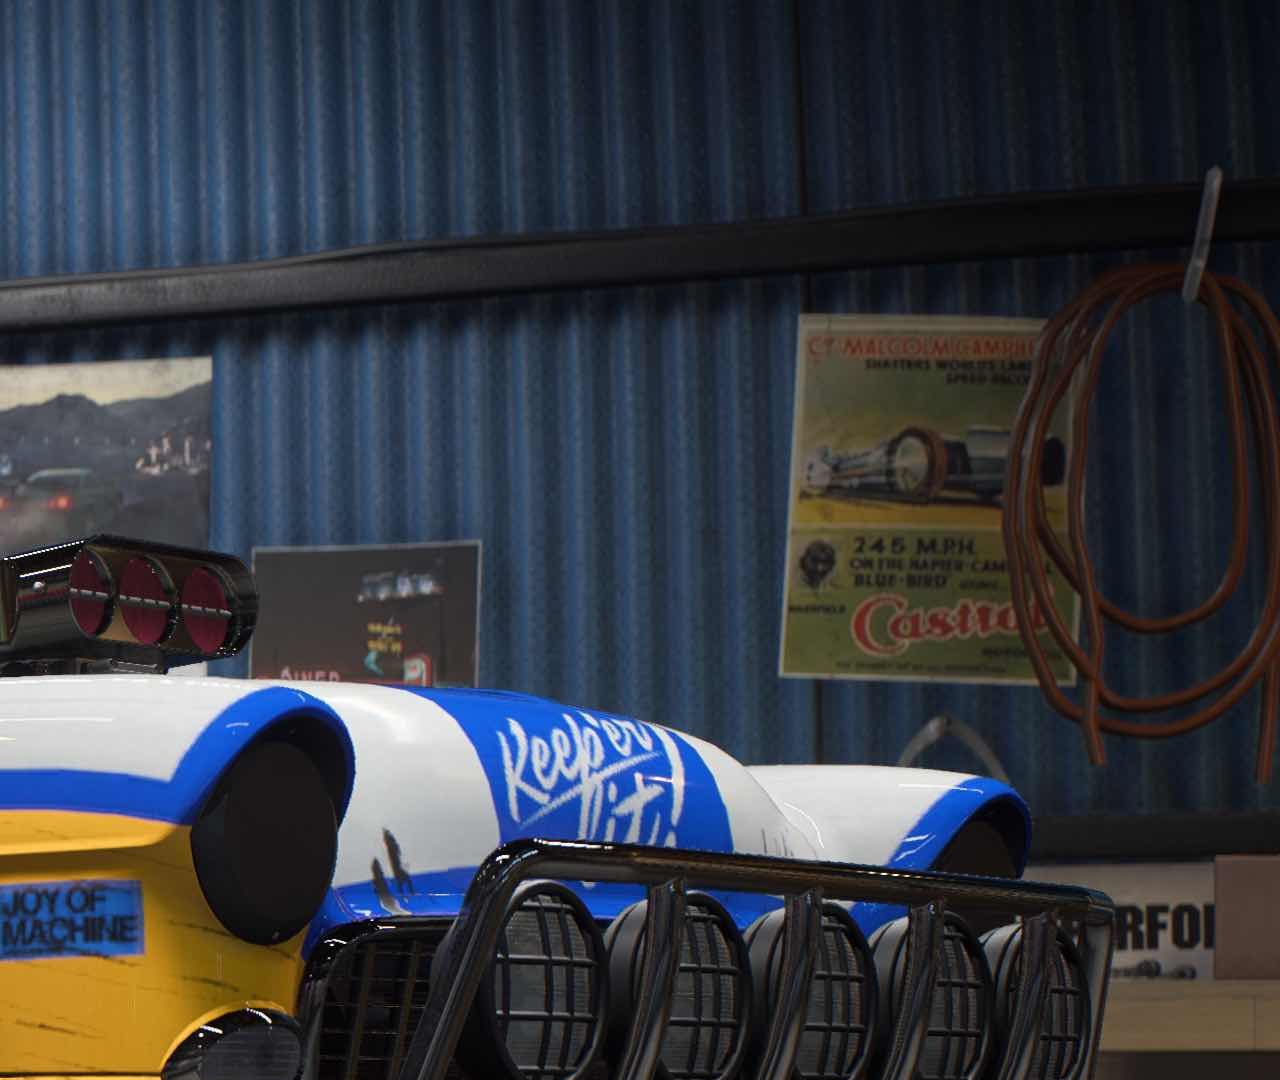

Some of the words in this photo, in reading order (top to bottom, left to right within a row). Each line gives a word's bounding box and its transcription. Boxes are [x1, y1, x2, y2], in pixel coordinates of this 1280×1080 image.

[0, 887, 57, 916] JOY
[64, 886, 106, 913] OF
[2, 915, 139, 945] MACHINE
[1112, 903, 1216, 950] RFO
